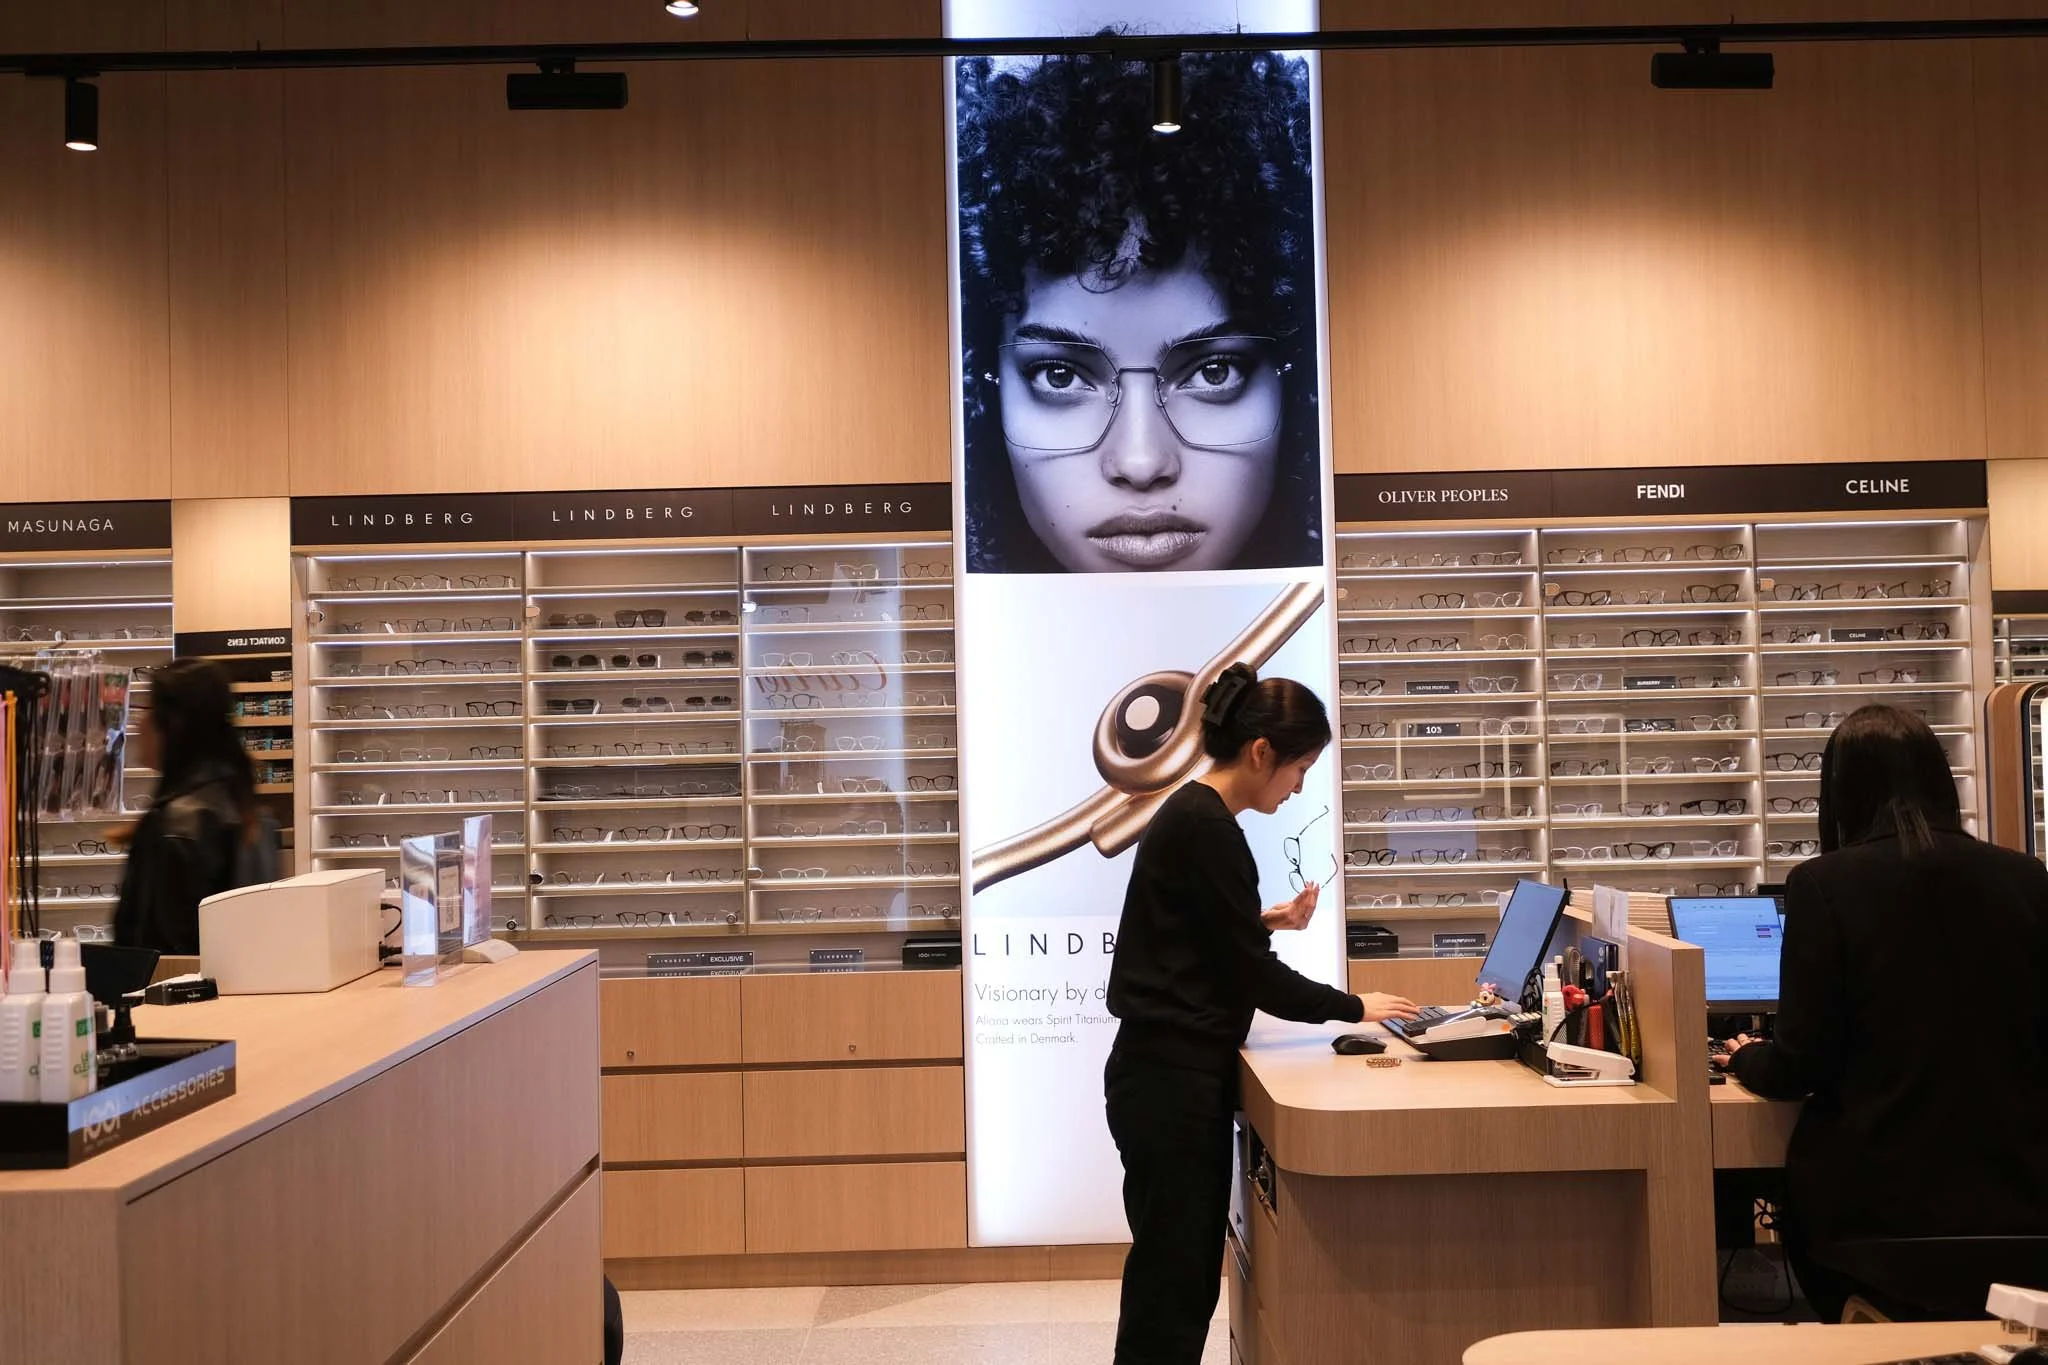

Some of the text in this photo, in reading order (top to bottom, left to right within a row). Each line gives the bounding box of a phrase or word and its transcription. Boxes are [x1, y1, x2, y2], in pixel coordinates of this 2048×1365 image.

[1637, 484, 1685, 499] FENDI
[1845, 478, 1910, 494] CELINE
[1378, 488, 1509, 504] OLIVER PEOPLES
[552, 506, 693, 522] LINDBERG
[772, 501, 912, 516] LINDBERG
[7, 518, 114, 533] MASUNAGA
[331, 512, 473, 526] LINDBERG
[974, 932, 1116, 956] LINDB
[710, 955, 744, 963] EXCLUSIVE
[974, 982, 1059, 1007] Visionary
[1066, 980, 1088, 1006] by
[1013, 1016, 1044, 1025] wears
[1046, 1014, 1073, 1028] Spirit
[976, 1031, 1079, 1045] Crafted in Denmark.
[132, 1065, 225, 1120] ACCESSORIES
